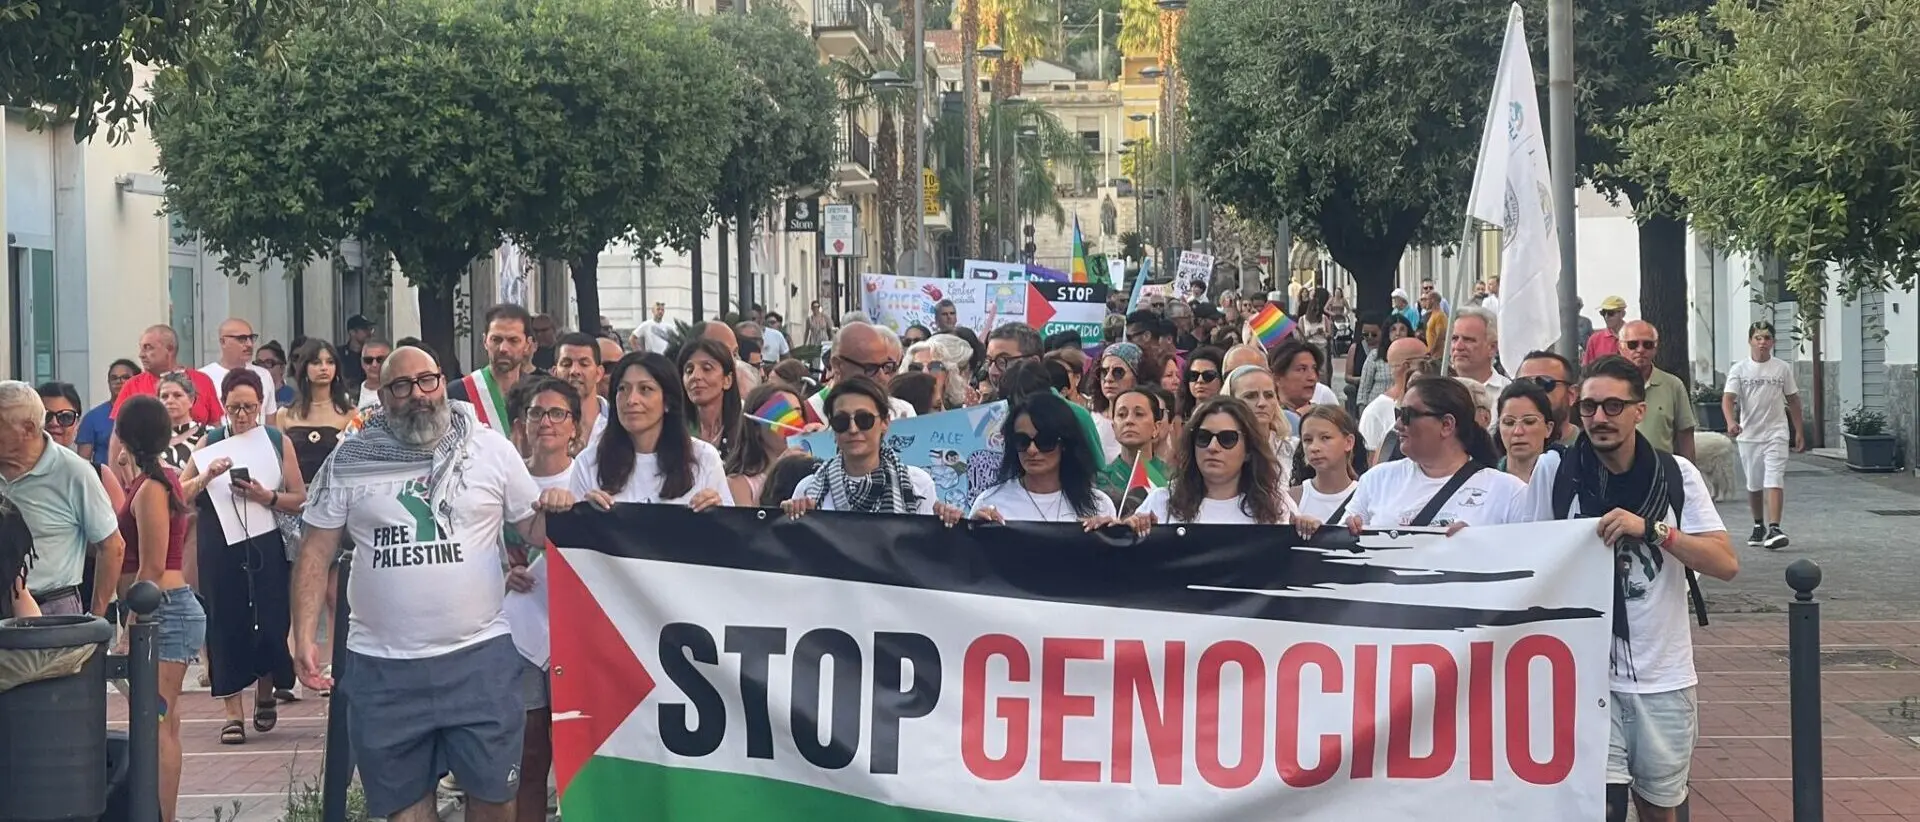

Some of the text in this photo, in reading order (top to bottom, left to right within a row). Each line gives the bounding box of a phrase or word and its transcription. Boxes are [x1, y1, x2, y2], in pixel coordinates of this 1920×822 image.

[795, 202, 809, 219] 3
[790, 219, 813, 230] Store
[1057, 287, 1094, 301] STOP
[929, 430, 964, 445] PACE
[374, 525, 410, 547] FREE
[372, 543, 464, 569] PALESTINE
[658, 622, 1577, 790] STOP GENOCIDIO
